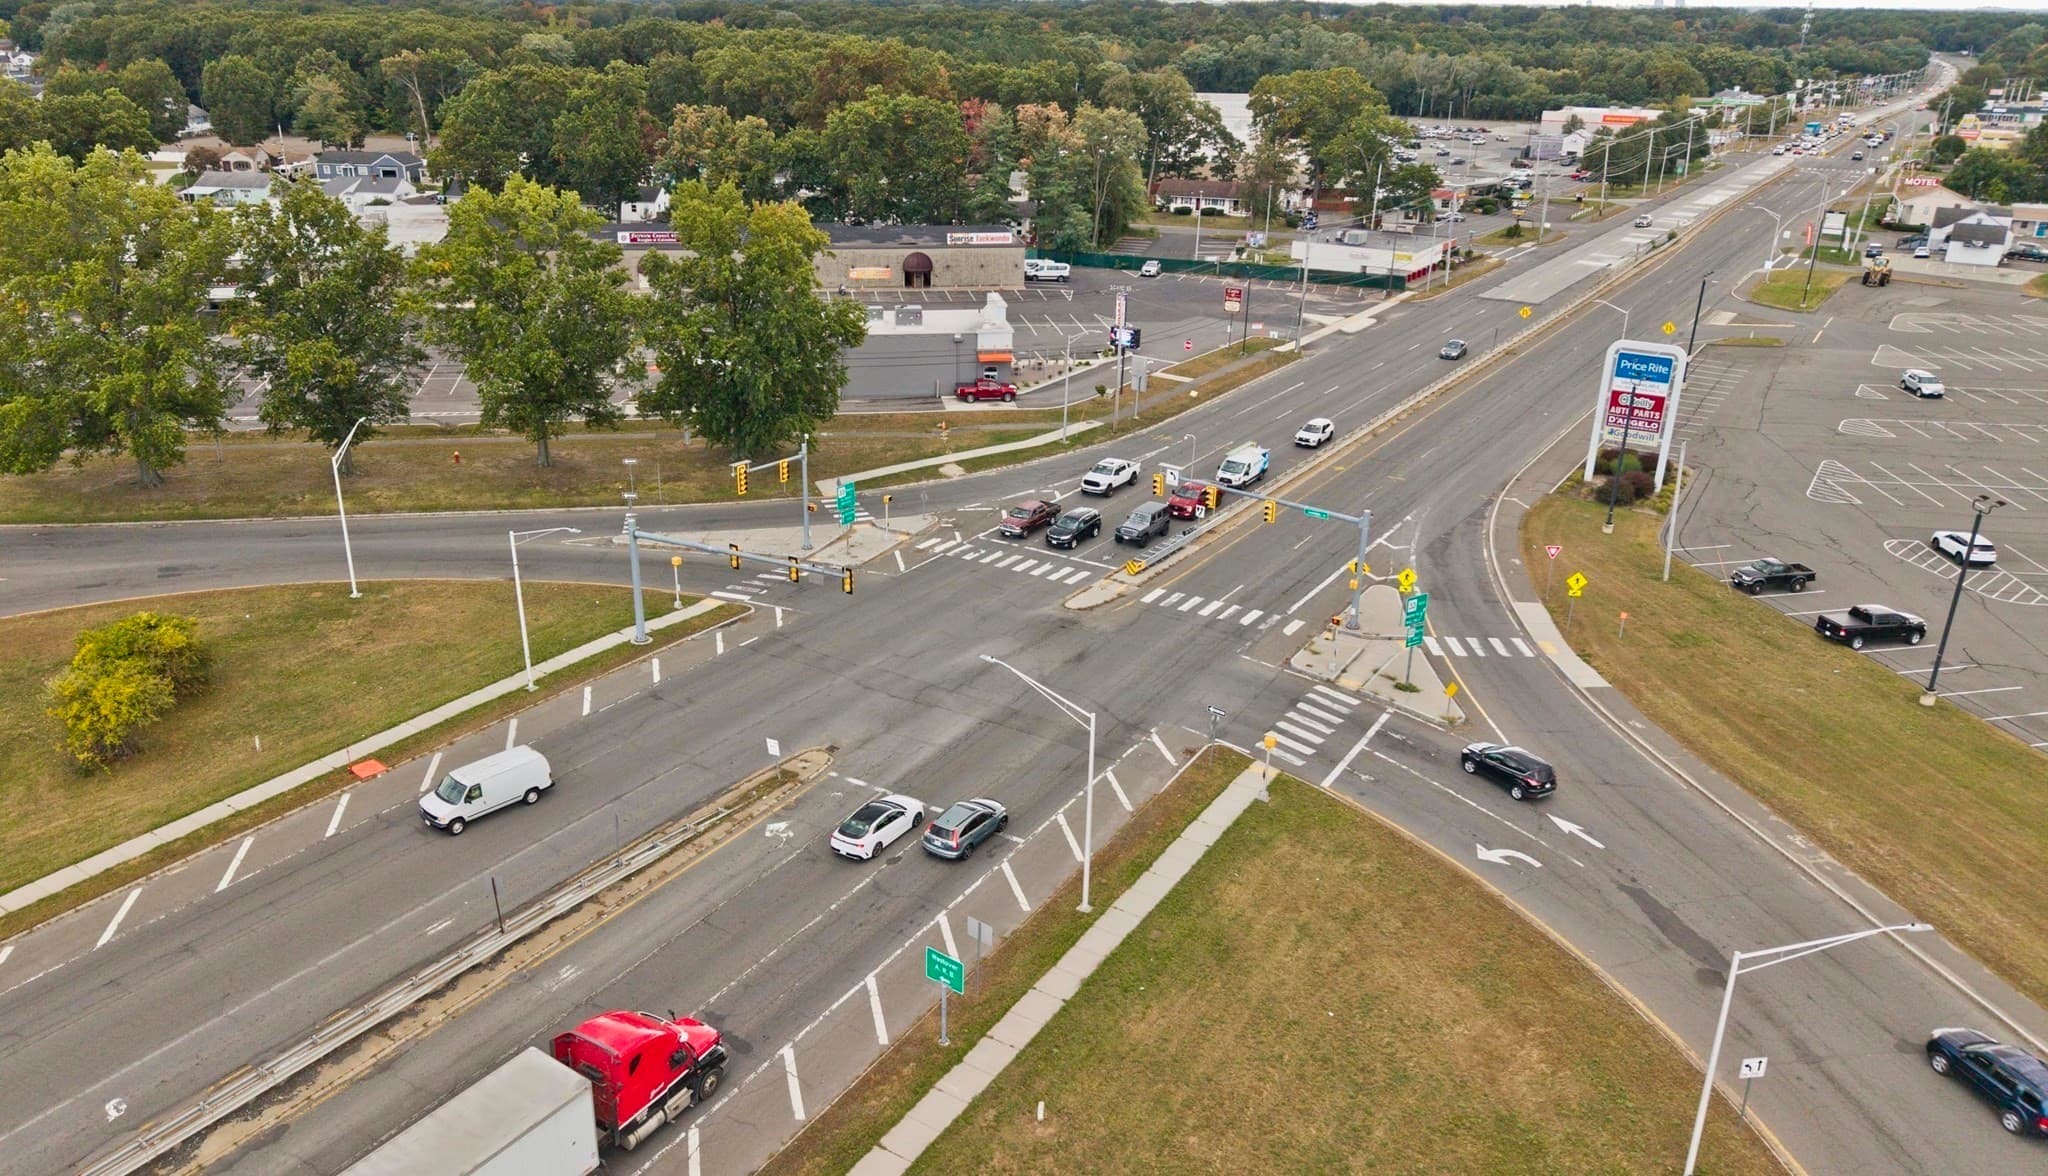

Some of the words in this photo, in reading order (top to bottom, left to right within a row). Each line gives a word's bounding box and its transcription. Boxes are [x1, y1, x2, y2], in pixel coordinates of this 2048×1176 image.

[1904, 178, 1937, 186] MOTEL
[1620, 359, 1647, 371] Price
[1648, 362, 1669, 374] Rite
[1633, 409, 1660, 419] PARTS
[1614, 430, 1655, 441] Goodwill
